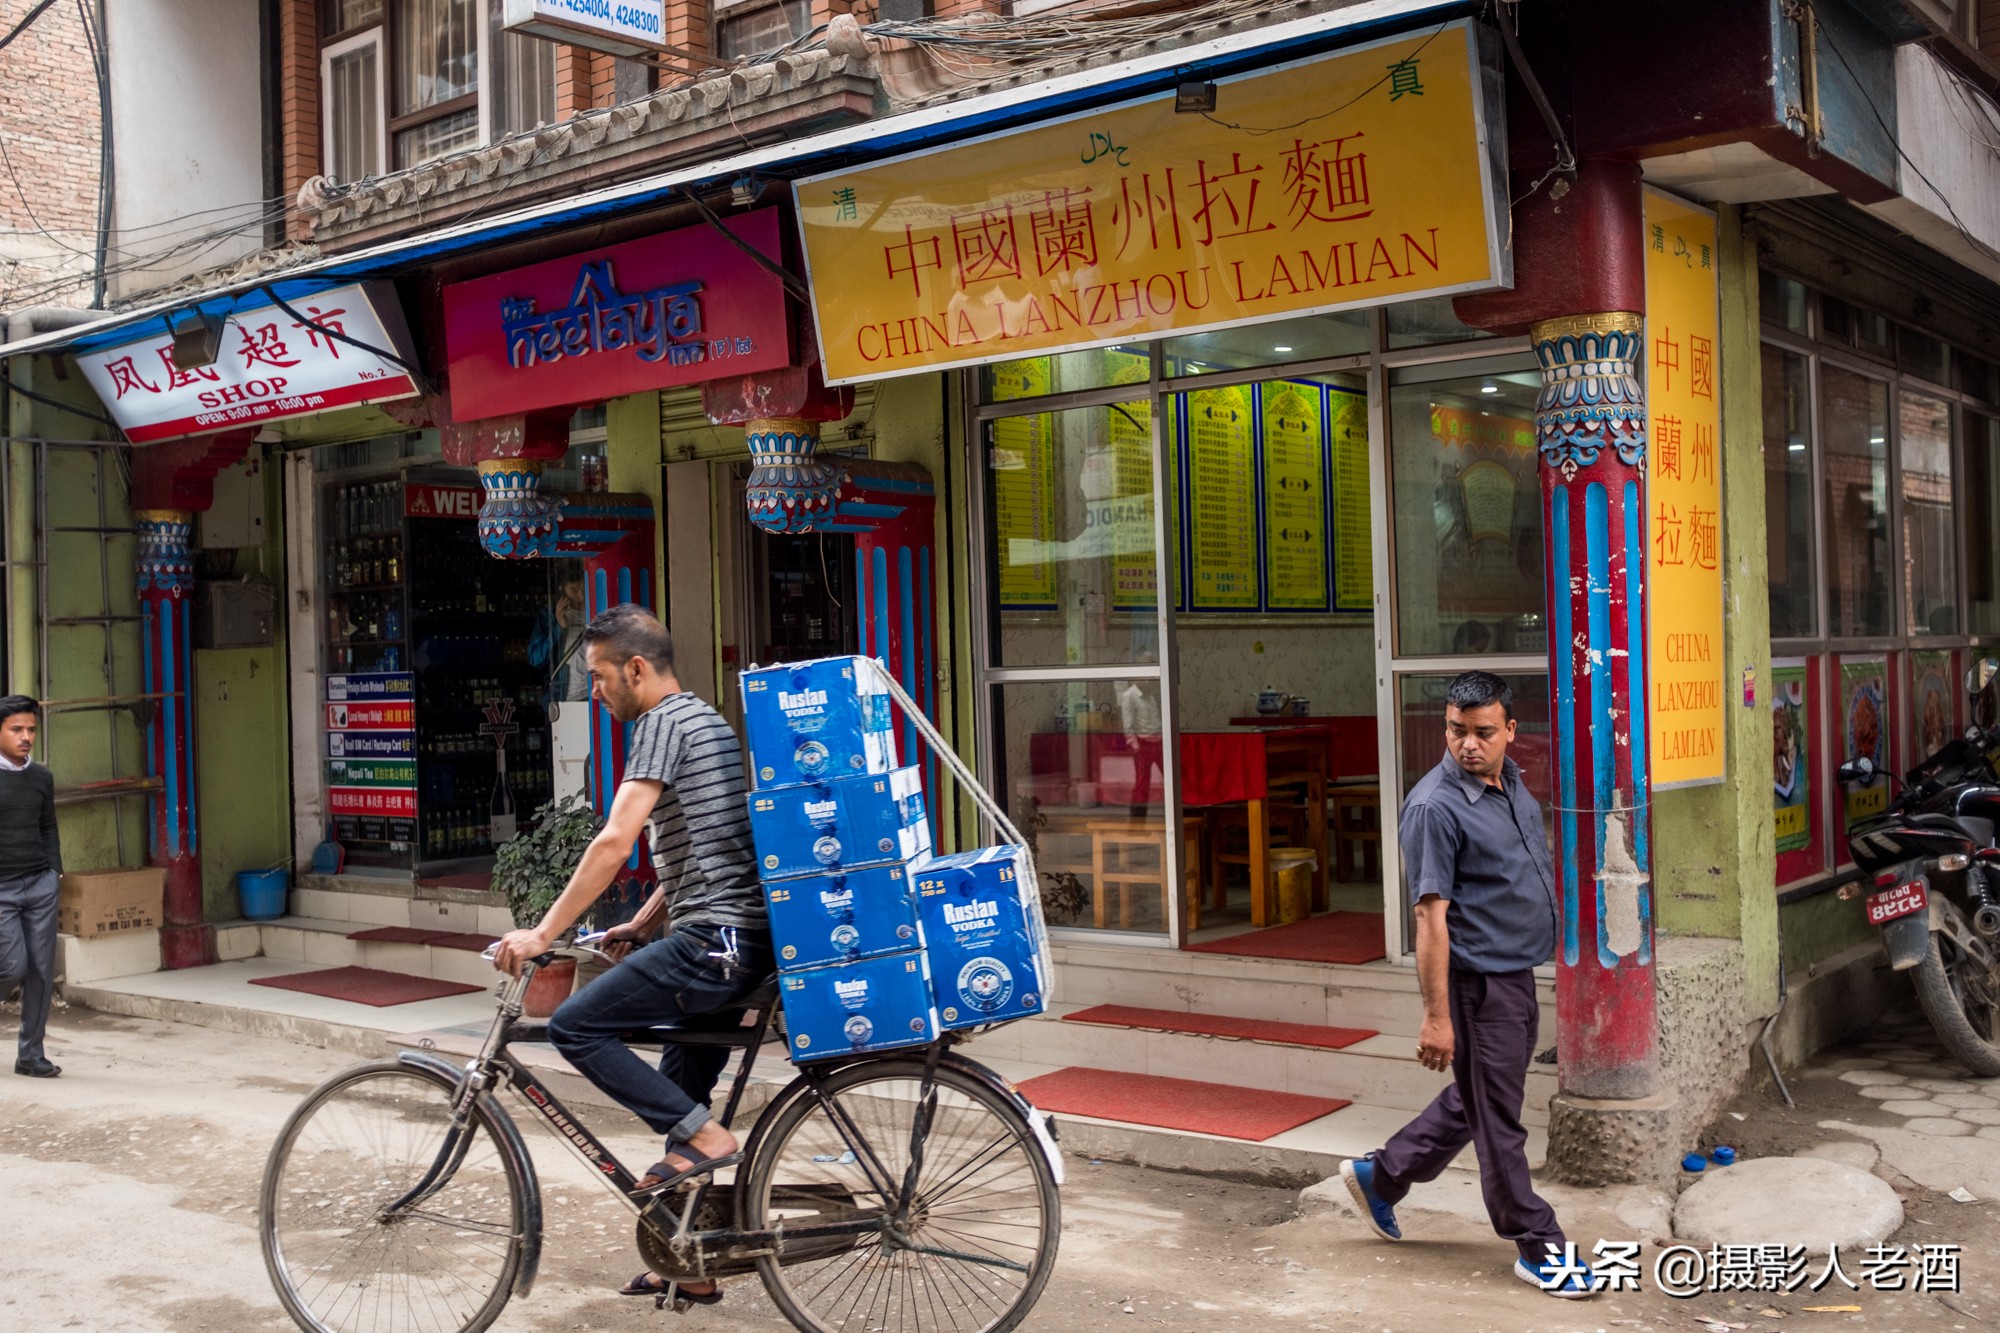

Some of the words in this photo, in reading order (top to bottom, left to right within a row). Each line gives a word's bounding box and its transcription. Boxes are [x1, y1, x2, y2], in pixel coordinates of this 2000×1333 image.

[616, 4, 659, 34] 4248300
[1386, 58, 1424, 102] 真
[1081, 130, 1131, 166] حلال
[832, 187, 857, 222] 清
[884, 131, 1374, 298] 中國蘭州拉麵
[857, 308, 982, 362] CHINA
[994, 267, 1210, 340] LANZHOU
[1231, 228, 1439, 303] LAMIAN
[358, 371, 377, 381] No.
[378, 368, 387, 377] 2
[1656, 326, 1712, 402] 中國
[197, 377, 288, 409] SHOP
[196, 411, 227, 426] OPEN:
[227, 406, 252, 421] 9:00
[253, 404, 270, 415] am
[275, 397, 305, 411] 10:00
[308, 394, 324, 408] pm
[1655, 413, 1713, 486] 蘭州
[433, 489, 481, 515] WEL
[1656, 501, 1717, 570] 拉麵
[1666, 633, 1711, 662] CHINA
[778, 688, 828, 710] Ruslan
[1657, 680, 1719, 712] LANZHOU
[784, 705, 824, 718] VODKA
[1662, 727, 1716, 761] LAMIAN
[347, 767, 364, 780] Nepali
[364, 767, 373, 779] Tea
[803, 799, 838, 815] Ruslan
[808, 811, 836, 820] VODKA
[819, 888, 854, 904] Ruslan
[919, 880, 934, 890] 12
[935, 880, 944, 888] x
[825, 899, 852, 909] VODKA
[942, 898, 999, 924] Ruslan
[951, 917, 996, 932] VODKA
[961, 960, 983, 979] PREMIUM
[984, 959, 1006, 974] QUALITY
[834, 978, 868, 994] Ruslan
[838, 990, 866, 999] VODKA
[543, 1104, 601, 1162] DHOOM
